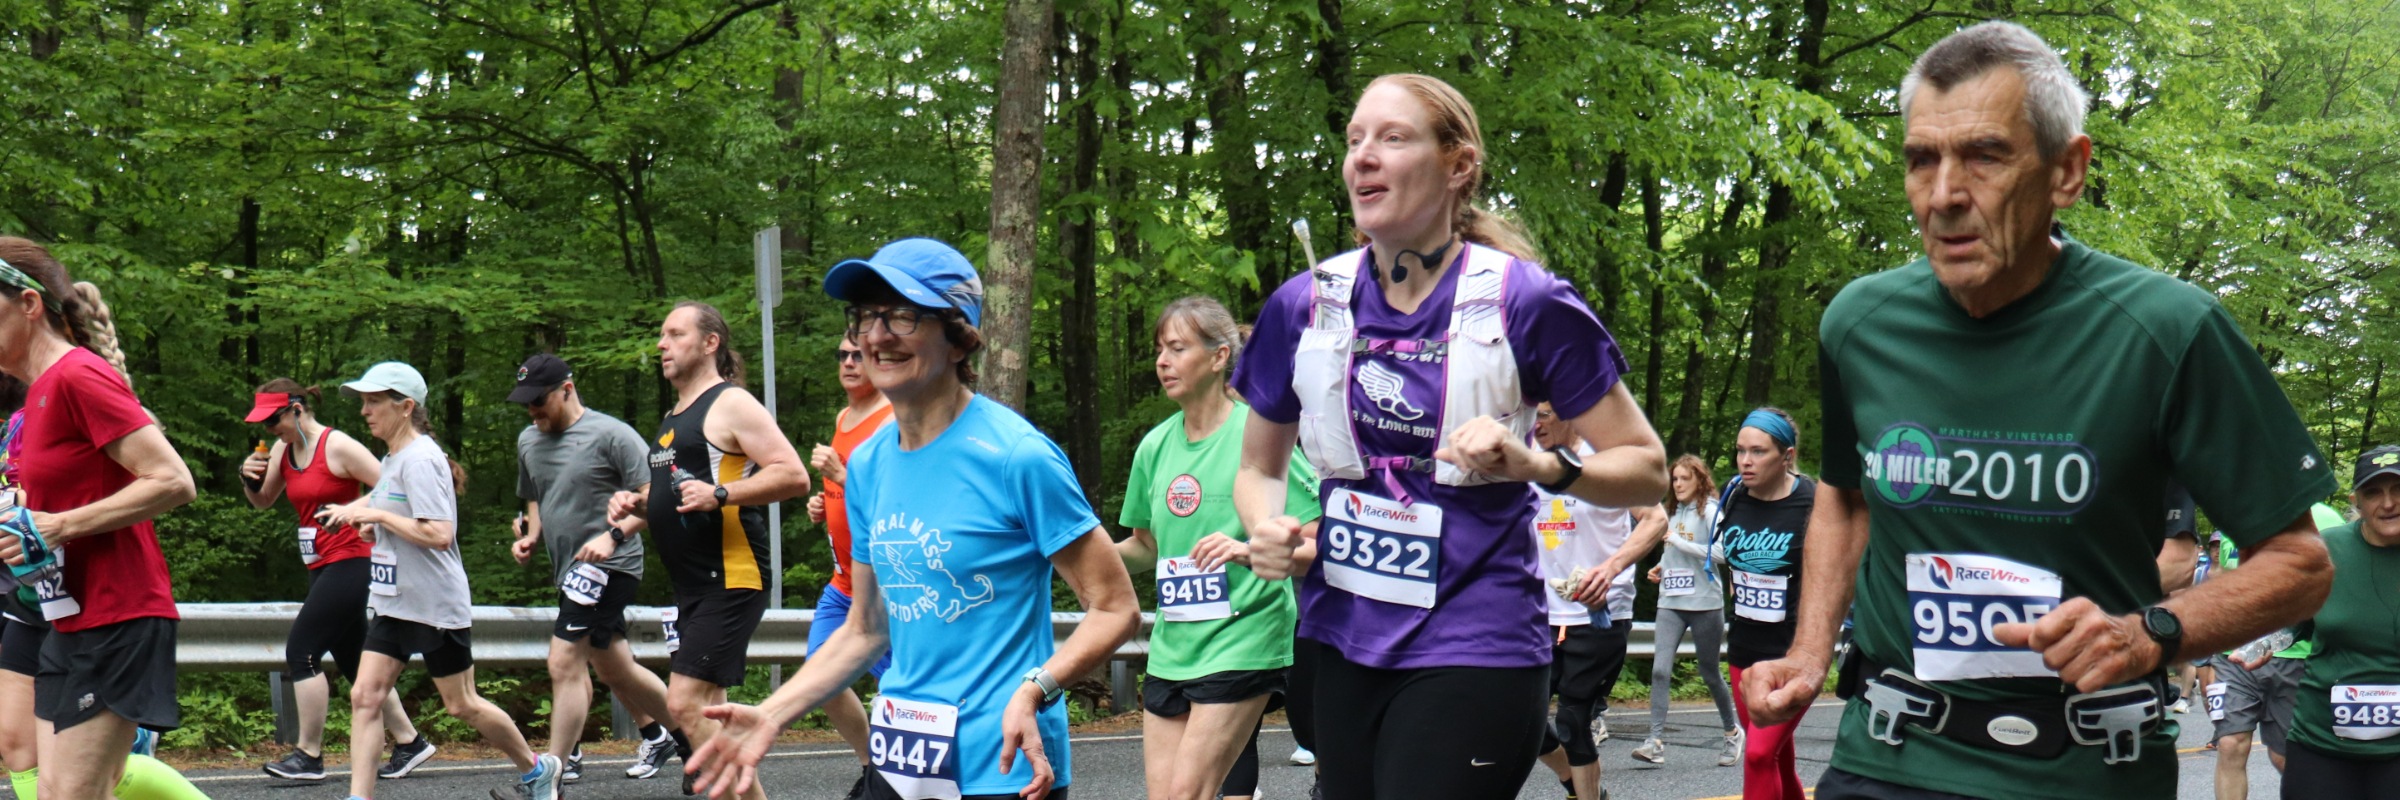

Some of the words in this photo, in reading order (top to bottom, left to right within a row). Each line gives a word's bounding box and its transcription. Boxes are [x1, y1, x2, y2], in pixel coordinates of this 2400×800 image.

[1377, 418, 1411, 433] LONG
[1938, 427, 2001, 440] MARTHA'S
[2006, 431, 2074, 442] VINEYARD
[1864, 452, 1882, 481] 20
[1886, 454, 1951, 487] MILER
[1949, 449, 2091, 504] 2010
[1363, 504, 1419, 523] RaceWire
[909, 517, 944, 571] MASS
[1329, 525, 1431, 578] 9322
[1724, 525, 1794, 558] Groton
[1744, 551, 1759, 560] ROAD
[1760, 551, 1776, 559] RACE
[563, 572, 603, 599] 9404
[1664, 576, 1694, 589] 9302
[1955, 566, 2030, 584] RaceWire
[1161, 576, 1222, 605] 9415
[1735, 586, 1783, 609] 9585
[895, 707, 938, 723] RaceWire
[870, 731, 949, 775] 9447
